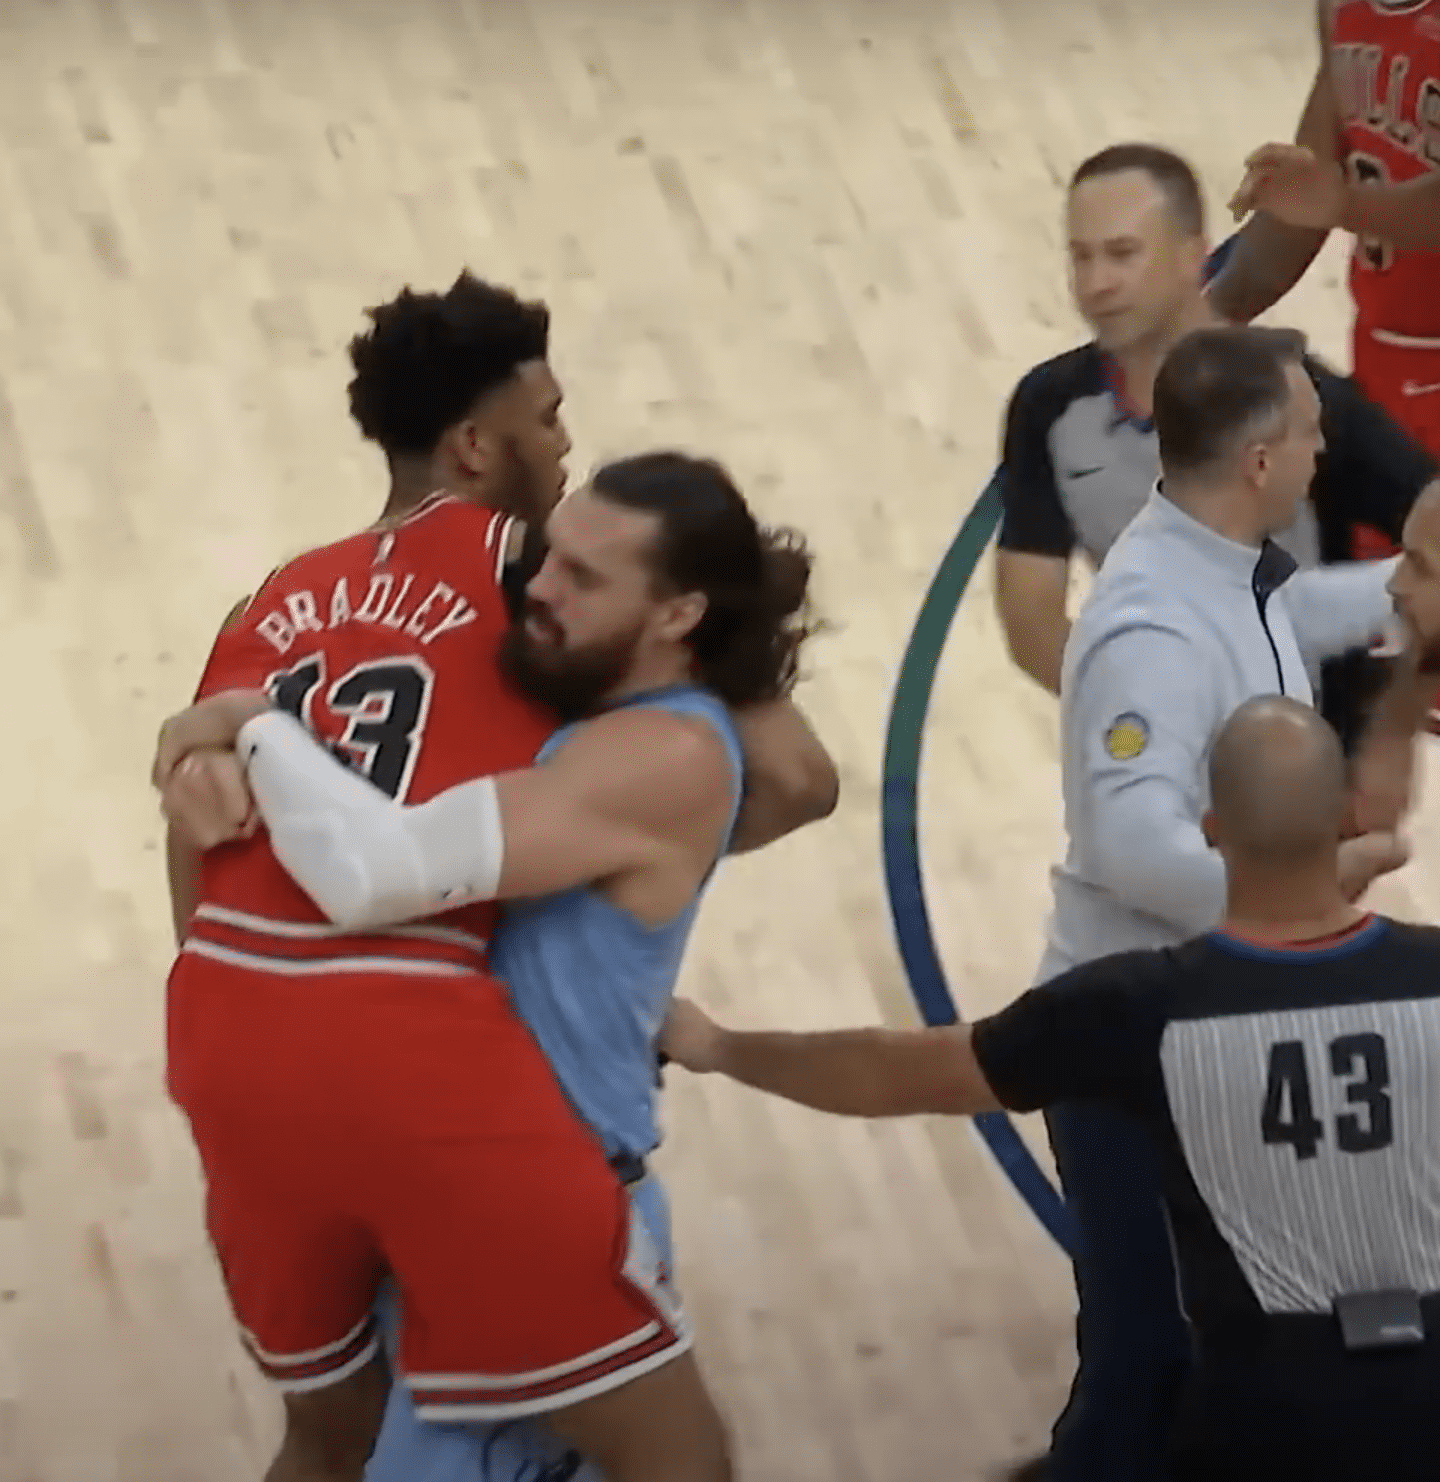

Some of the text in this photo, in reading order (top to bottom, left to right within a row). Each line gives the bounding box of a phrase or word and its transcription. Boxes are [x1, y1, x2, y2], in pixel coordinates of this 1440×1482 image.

[256, 573, 478, 655] BRADLEY
[264, 650, 435, 805] 13
[1260, 1032, 1394, 1161] 43
